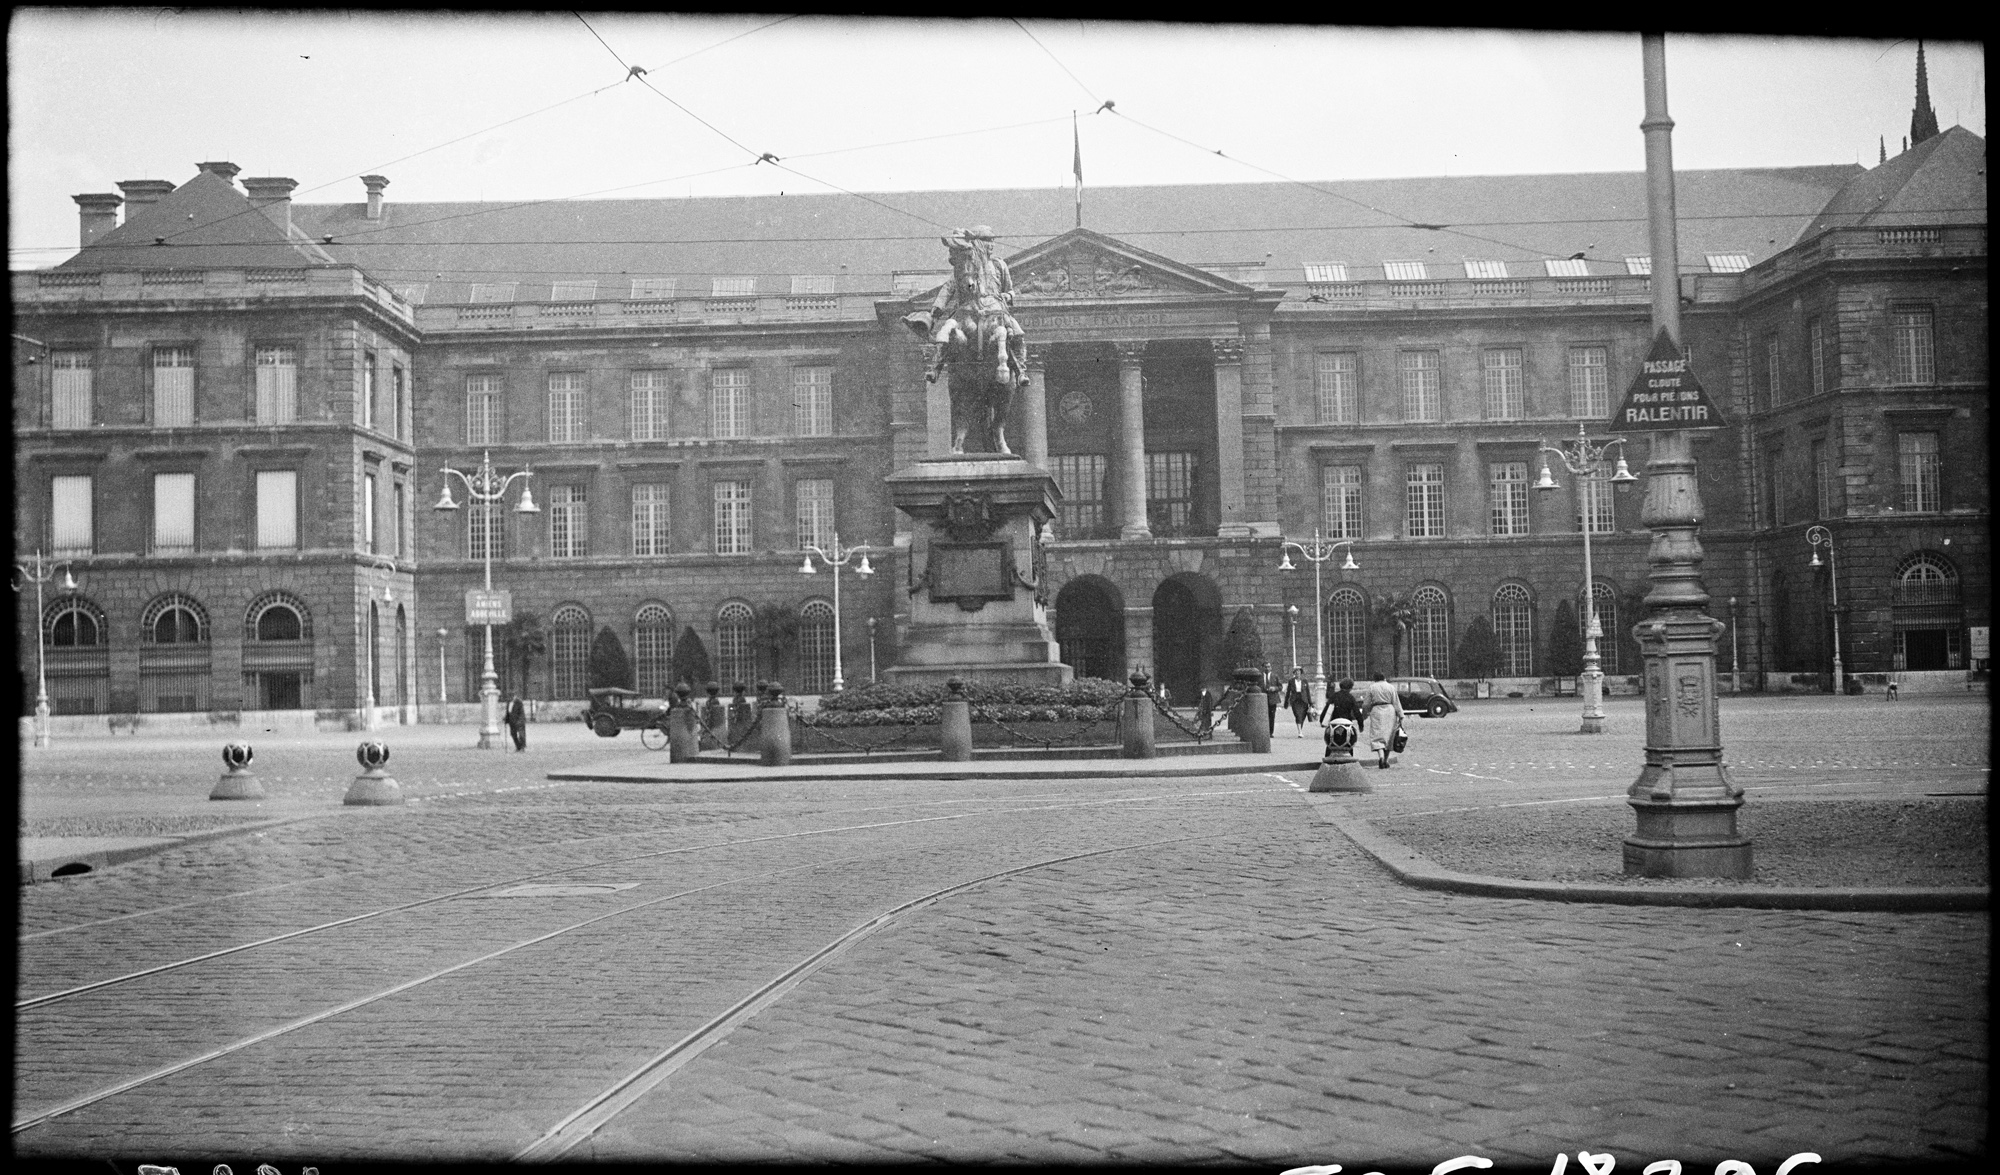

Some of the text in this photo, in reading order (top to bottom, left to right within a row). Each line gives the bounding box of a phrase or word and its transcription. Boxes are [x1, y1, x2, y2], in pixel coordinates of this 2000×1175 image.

[1644, 360, 1686, 373] PASSAGE
[1633, 393, 1659, 403] POUR
[1626, 405, 1708, 422] RALENTIR
